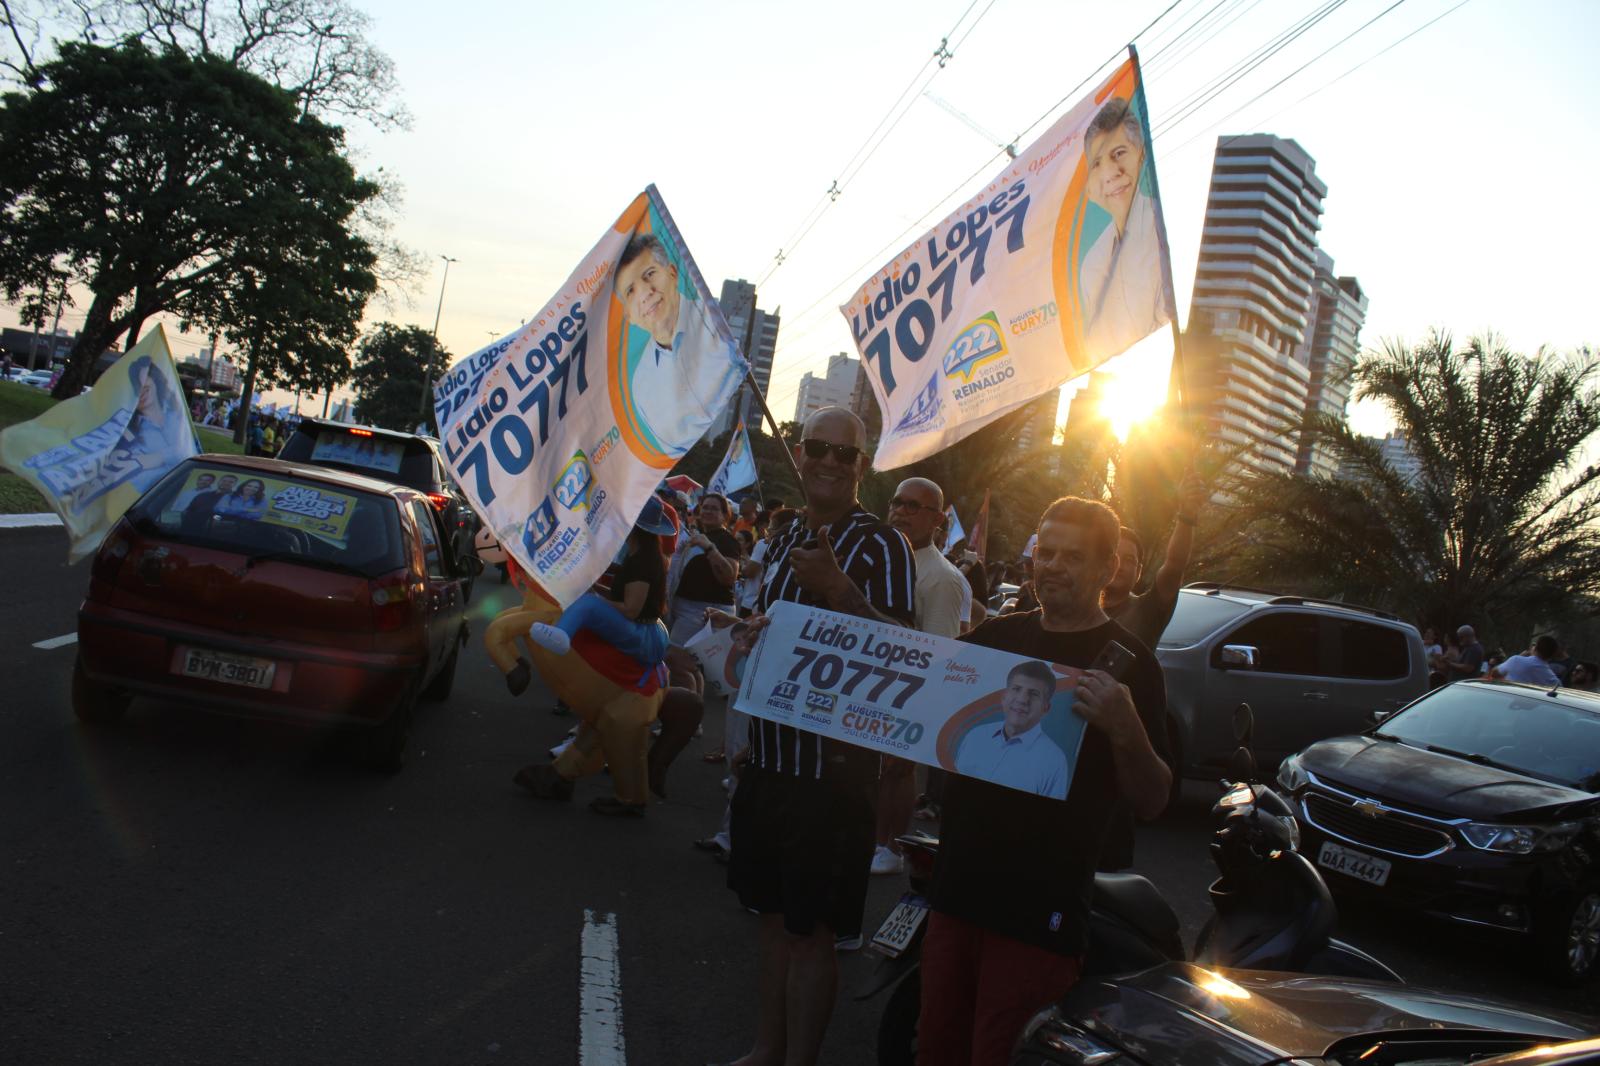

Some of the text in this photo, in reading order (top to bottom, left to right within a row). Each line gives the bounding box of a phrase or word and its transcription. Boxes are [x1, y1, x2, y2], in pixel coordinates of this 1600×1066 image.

[927, 178, 1026, 271] Lopes
[864, 194, 1031, 398] 70777
[505, 301, 587, 391] Lopes
[944, 325, 997, 372] 222
[953, 367, 1015, 401] REINALDO
[457, 329, 588, 507] 70777
[555, 461, 591, 506] 222
[536, 526, 581, 575] RIEDEL
[799, 619, 933, 669] Lidio Lopes
[810, 611, 937, 646] DEPUTADO ESTADUAL
[787, 647, 926, 710] 70777
[807, 692, 834, 709] 222
[767, 698, 795, 712] RIEDEL
